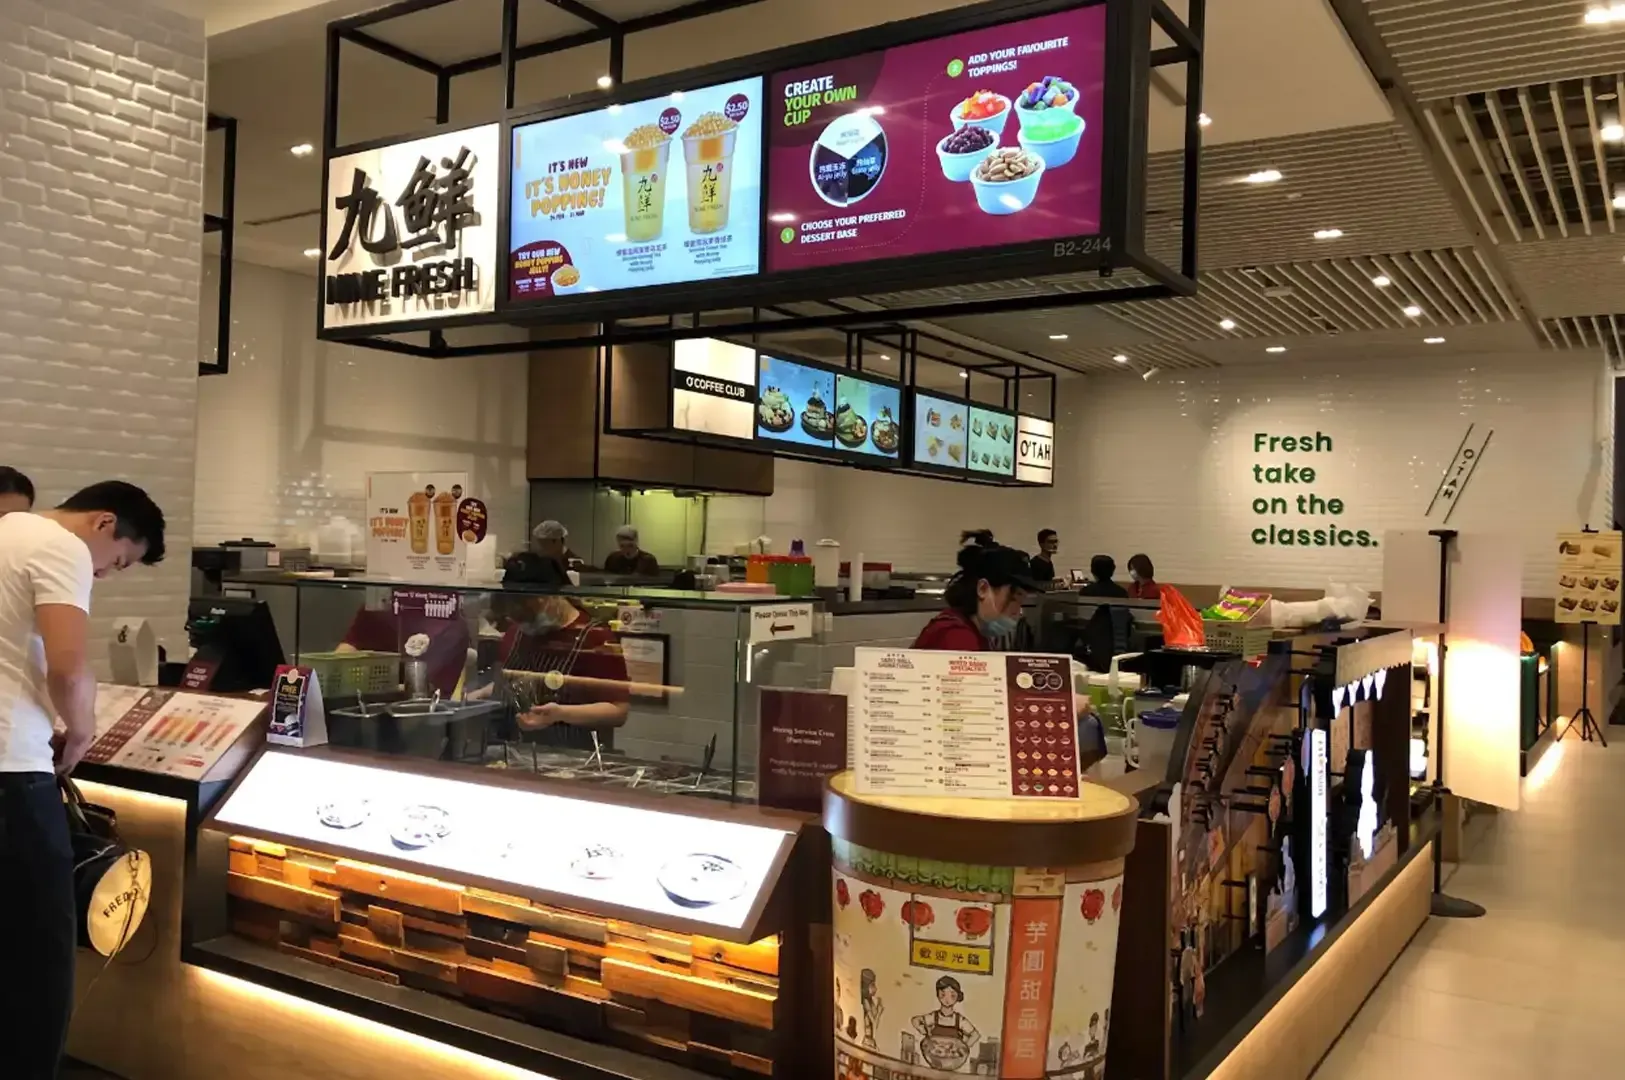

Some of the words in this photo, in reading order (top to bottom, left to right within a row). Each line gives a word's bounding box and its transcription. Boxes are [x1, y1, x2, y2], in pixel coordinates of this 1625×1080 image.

[967, 53, 987, 66] ADD
[989, 47, 1015, 61] YOUR
[1017, 36, 1069, 56] FAVOURITE
[968, 59, 1018, 78] TOPPINGS!
[784, 75, 834, 98] CREATE
[727, 101, 748, 113] $2.50
[784, 92, 821, 112] YOUR
[823, 85, 857, 105] OWN
[660, 115, 680, 127] $2.50
[783, 109, 811, 127] CUP
[548, 160, 565, 174] IT'S
[568, 156, 588, 170] NEW
[525, 176, 554, 199] IT'S
[558, 167, 612, 192] HONEY
[328, 145, 475, 261] 九鮮
[530, 188, 606, 218] POPPING!
[801, 219, 834, 231] CHOOSE
[834, 215, 857, 226] YOUR
[858, 209, 906, 223] PREFERRED
[801, 230, 836, 243] DESSERT
[836, 228, 858, 238] BASE
[1054, 236, 1112, 257] B2-244
[326, 269, 386, 305] NINE
[391, 257, 474, 298] FRESH
[725, 384, 745, 398] CLUB
[1020, 439, 1052, 461] O'TAH
[1254, 431, 1333, 453] Fresh
[1253, 462, 1316, 484] take
[1252, 497, 1287, 515] on
[1296, 493, 1344, 515] the
[1251, 524, 1379, 548] classics.
[794, 728, 817, 736] Service
